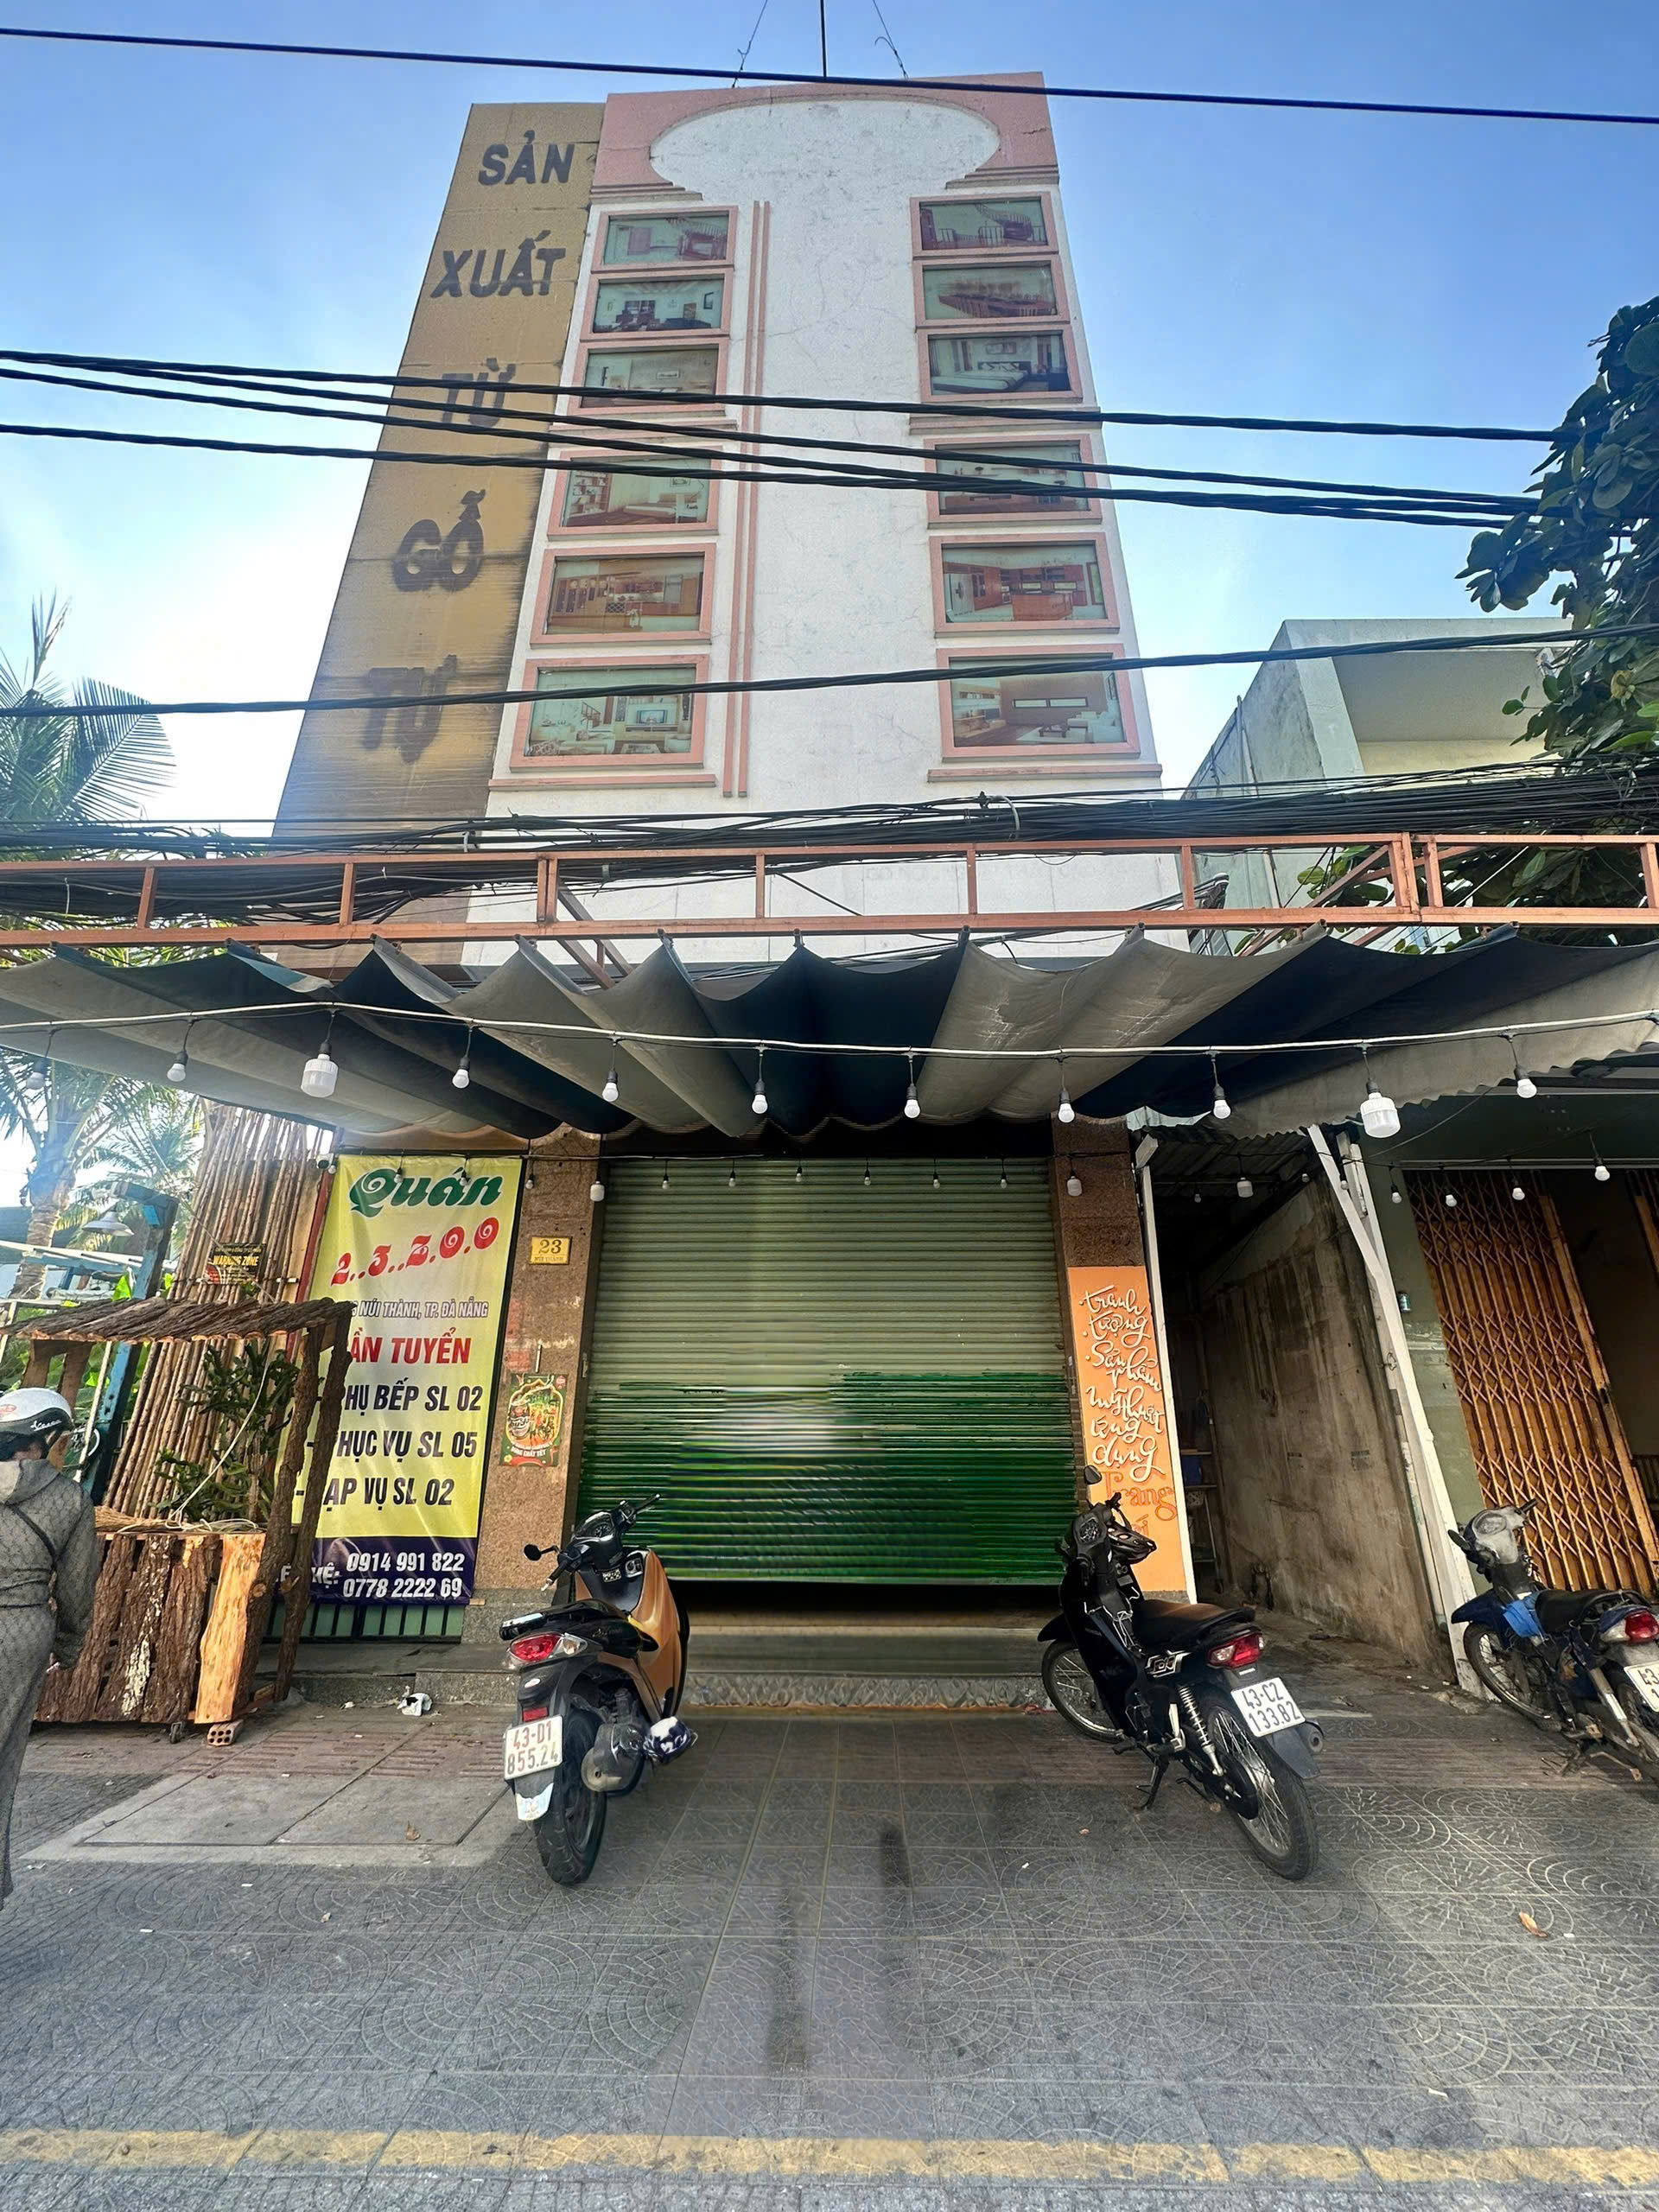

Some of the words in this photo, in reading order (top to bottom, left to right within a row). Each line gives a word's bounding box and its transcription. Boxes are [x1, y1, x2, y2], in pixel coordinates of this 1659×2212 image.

[478, 130, 575, 186] SẢN
[430, 230, 567, 298] XUẤT
[441, 357, 517, 428] TỪ
[349, 1166, 504, 1218] Quán
[241, 1255, 259, 1267] ZONE
[538, 1238, 562, 1255] 23
[359, 1298, 381, 1318] NÚI
[382, 1298, 423, 1320] THÀNH,
[423, 1300, 440, 1319] TP.
[441, 1298, 457, 1319] ĐÀ
[350, 1327, 383, 1363] ẦN
[391, 1326, 472, 1364] TUYỂN
[344, 1384, 370, 1416] HỤ
[373, 1377, 419, 1411] BẾP
[424, 1385, 449, 1412] SL
[456, 1385, 483, 1412] 02
[336, 1430, 378, 1463] HỤC
[383, 1430, 412, 1463] VỤ
[416, 1431, 443, 1459] SL
[451, 1431, 478, 1459] 05
[1090, 1414, 1144, 1445] ứng
[1091, 1434, 1166, 1484] dụng
[322, 1478, 358, 1512] ẠP
[364, 1477, 388, 1511] VỤ
[392, 1477, 416, 1505] SL
[424, 1478, 454, 1506] 02
[346, 1552, 391, 1573] 0914
[396, 1552, 425, 1573] 991
[432, 1552, 466, 1573] 822
[342, 1577, 389, 1599] 0778
[391, 1577, 436, 1599] 2222
[440, 1577, 463, 1599] 69
[1248, 1700, 1302, 1733] 133.82
[512, 1719, 552, 1751] 43-D1
[506, 1741, 559, 1776] 855.24
